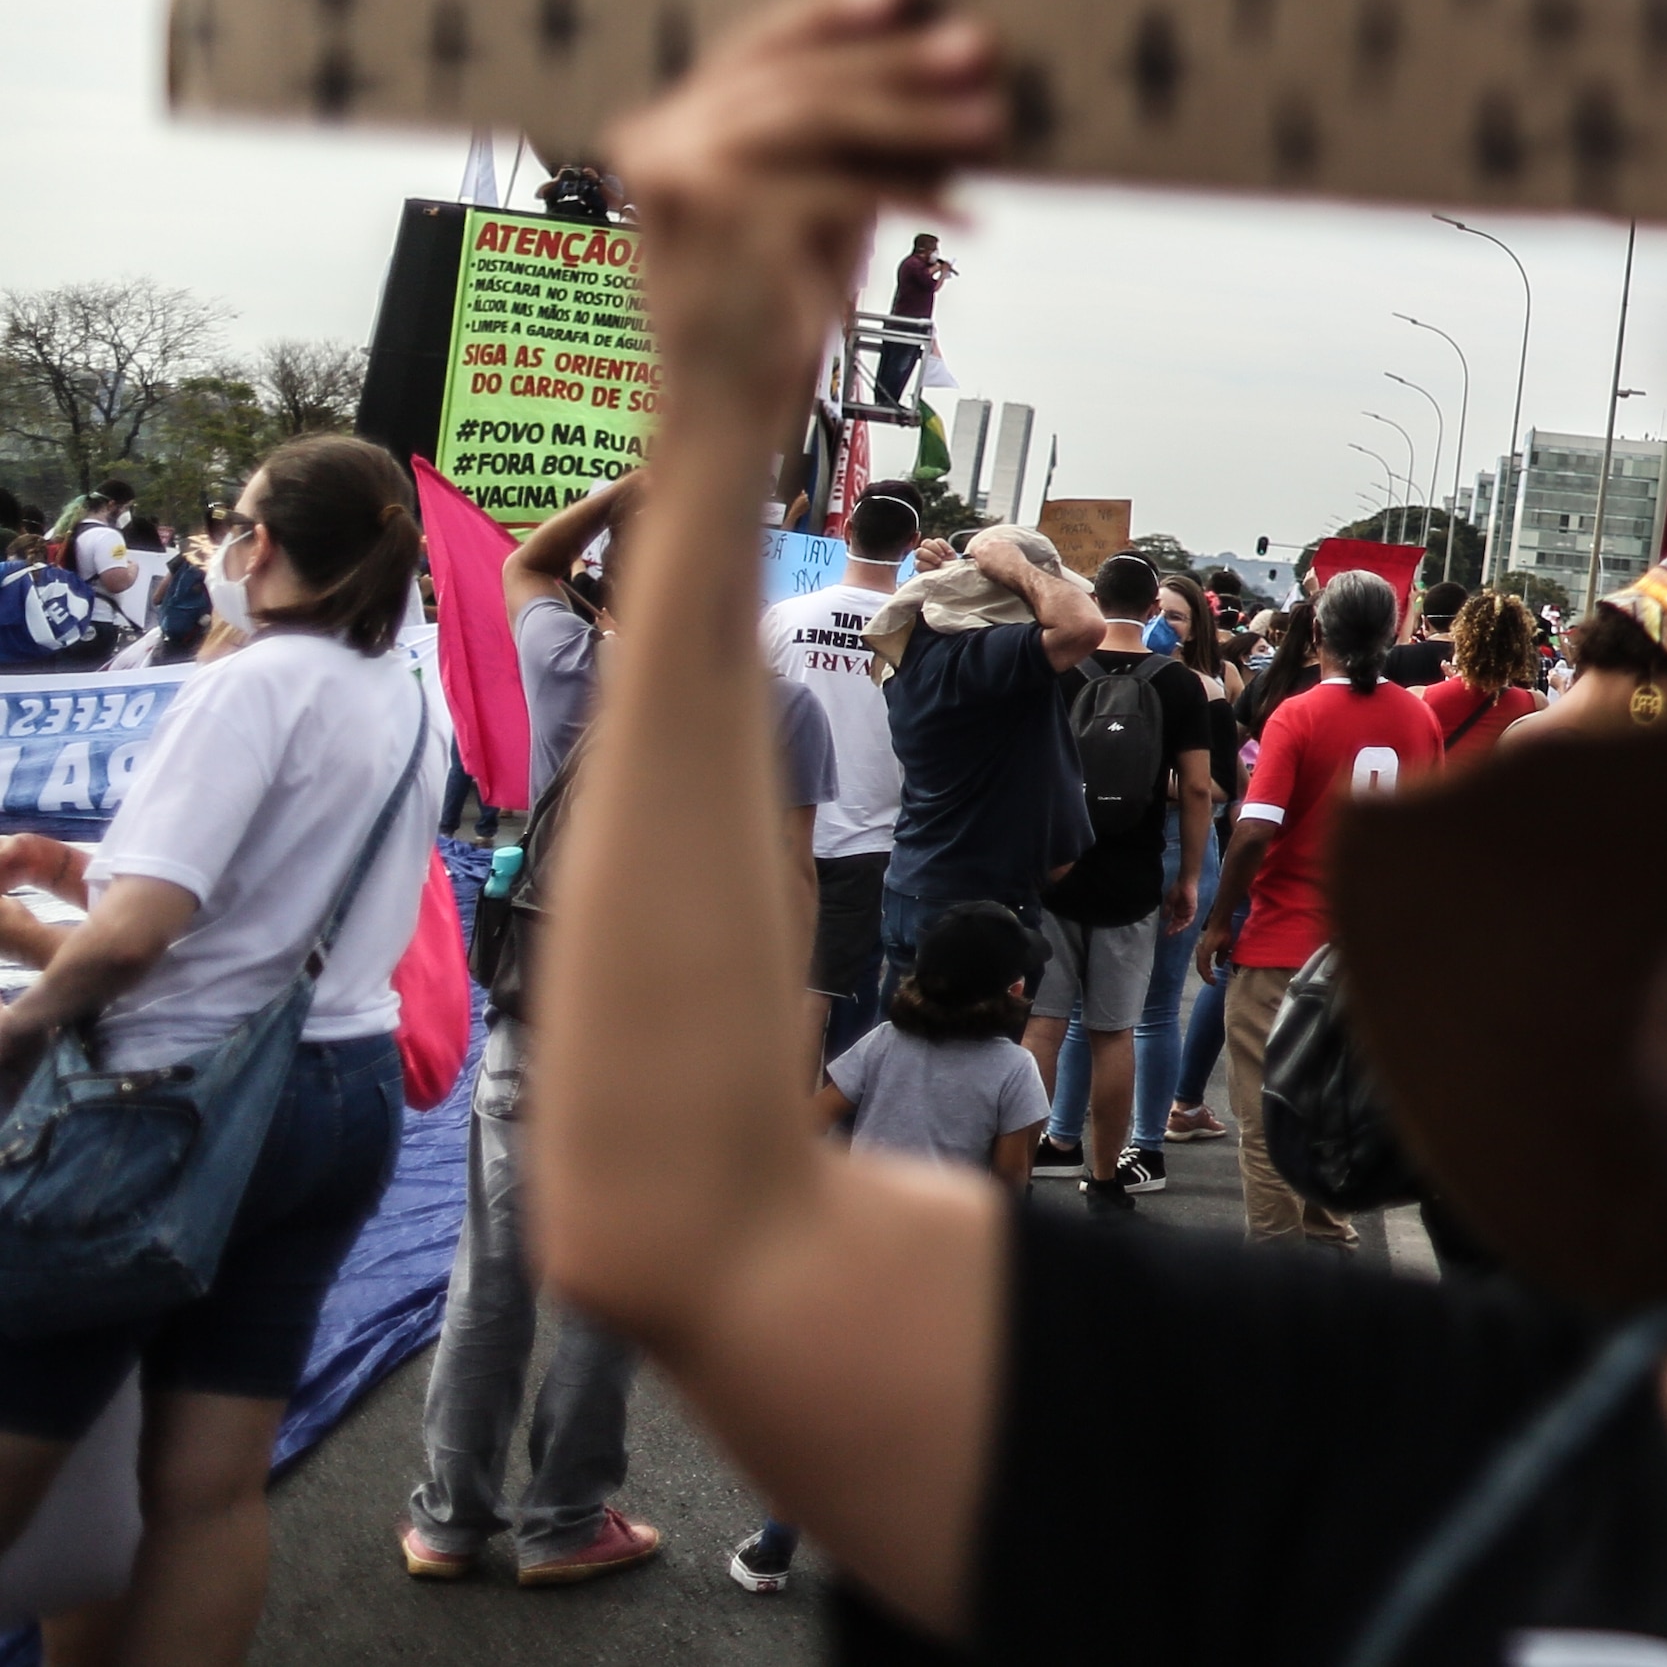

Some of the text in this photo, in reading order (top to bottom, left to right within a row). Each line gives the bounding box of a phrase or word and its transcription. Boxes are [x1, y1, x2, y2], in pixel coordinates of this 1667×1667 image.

[475, 221, 645, 274] ATENÇÃO!
[477, 259, 648, 291] DISTANCIAMENTO SOCIA
[475, 276, 650, 312] MÁSCARA NO ROSTO (NA
[473, 294, 656, 333] ÁLCOOL NAS MÃOS AO MANIPULA
[471, 320, 509, 334] LIMPE
[511, 321, 522, 334] A
[526, 323, 590, 345] GARRAFA
[593, 334, 612, 348] DE
[614, 329, 652, 352] ÁGUA
[462, 343, 664, 391] SIGA AS ORIENTAÇ
[471, 372, 503, 395] DO
[510, 375, 585, 402] CARRO
[591, 386, 622, 409] DE
[456, 419, 544, 444] #POVO
[552, 423, 586, 447] NA
[453, 452, 535, 476] #FORA
[792, 629, 874, 652] TERNET
